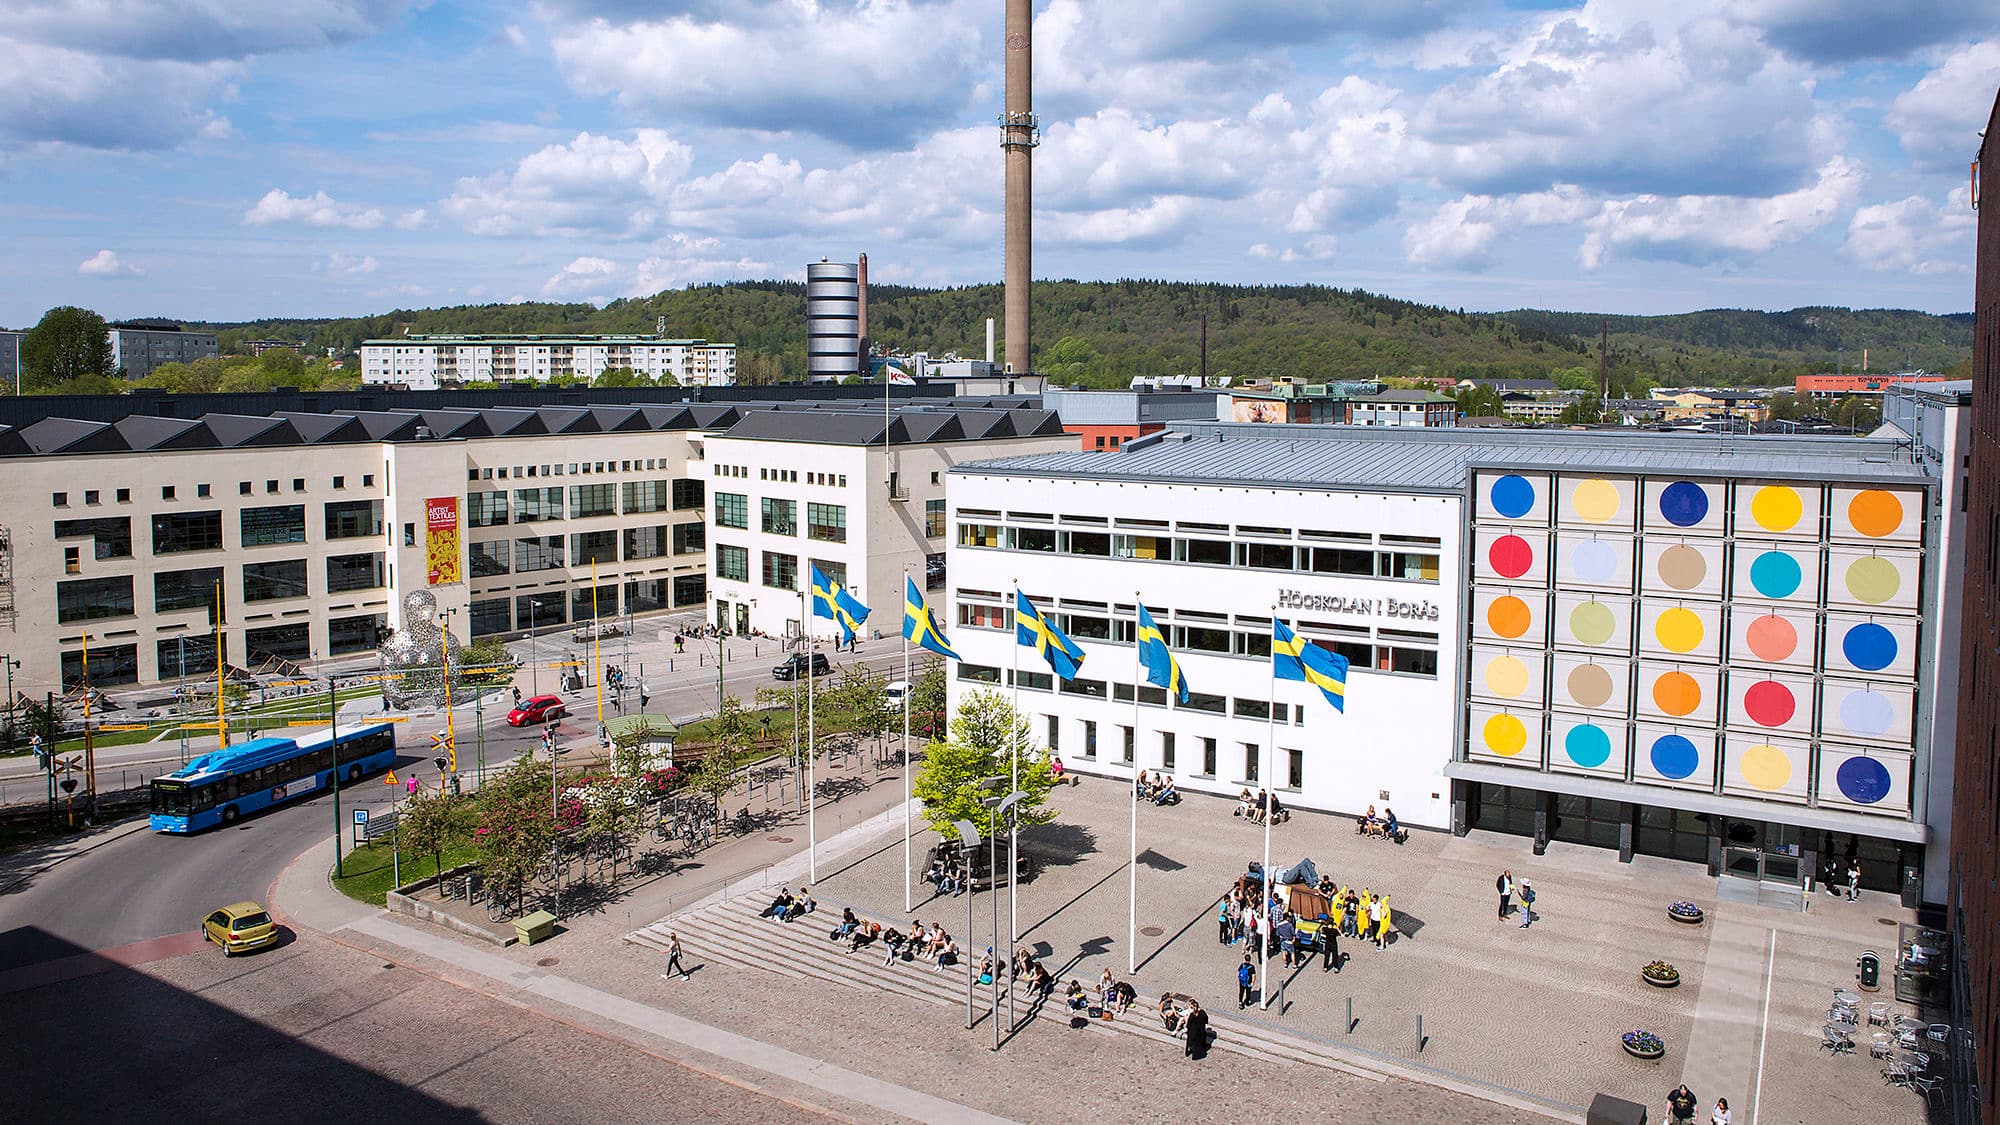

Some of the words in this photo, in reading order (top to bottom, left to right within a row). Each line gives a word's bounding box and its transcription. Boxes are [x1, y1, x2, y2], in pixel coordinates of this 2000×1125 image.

[429, 507, 449, 515] ARTIST
[429, 511, 456, 520] TEXTILES
[1278, 588, 1373, 615] HÖGSKOLAN
[1387, 597, 1439, 622] BORÅS
